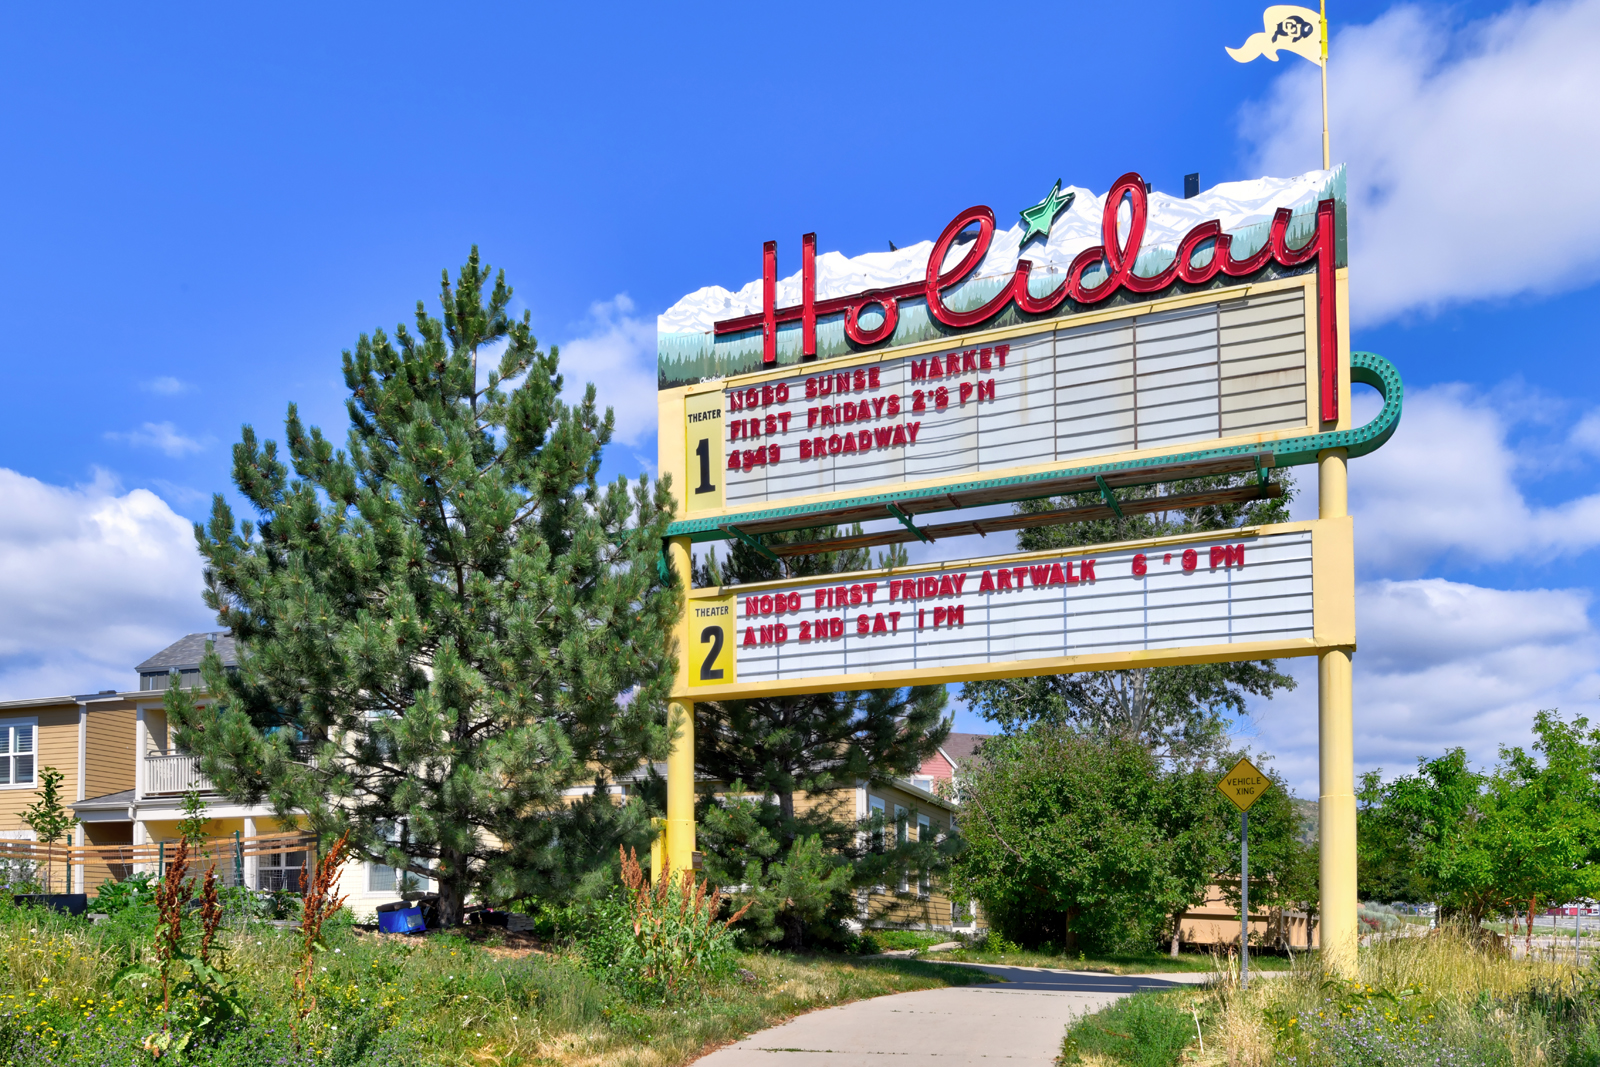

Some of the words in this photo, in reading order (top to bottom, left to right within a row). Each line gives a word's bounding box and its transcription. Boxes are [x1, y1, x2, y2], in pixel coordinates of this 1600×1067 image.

[714, 172, 1335, 422] Holiday
[730, 382, 790, 411] NOBO
[804, 366, 881, 399] SUNSE
[911, 344, 1010, 382] MARKET
[687, 408, 722, 424] THEATER
[730, 411, 792, 440] FIRST
[694, 438, 716, 495] 1
[727, 443, 781, 472] 4949
[799, 421, 921, 460] BROADWAY
[745, 591, 802, 616] NOBO
[814, 582, 878, 609] FIRST
[889, 573, 967, 601] FRIDAY
[979, 559, 1097, 592] ARTWALK
[1209, 543, 1245, 569] PM
[694, 605, 730, 618] THEATER
[742, 622, 789, 646] AND
[798, 616, 845, 641] 2ND
[856, 611, 901, 635] SAT
[933, 604, 965, 628] PM
[699, 625, 725, 681] 2
[1226, 776, 1262, 786] VEHICLE
[1235, 787, 1255, 796] XING
